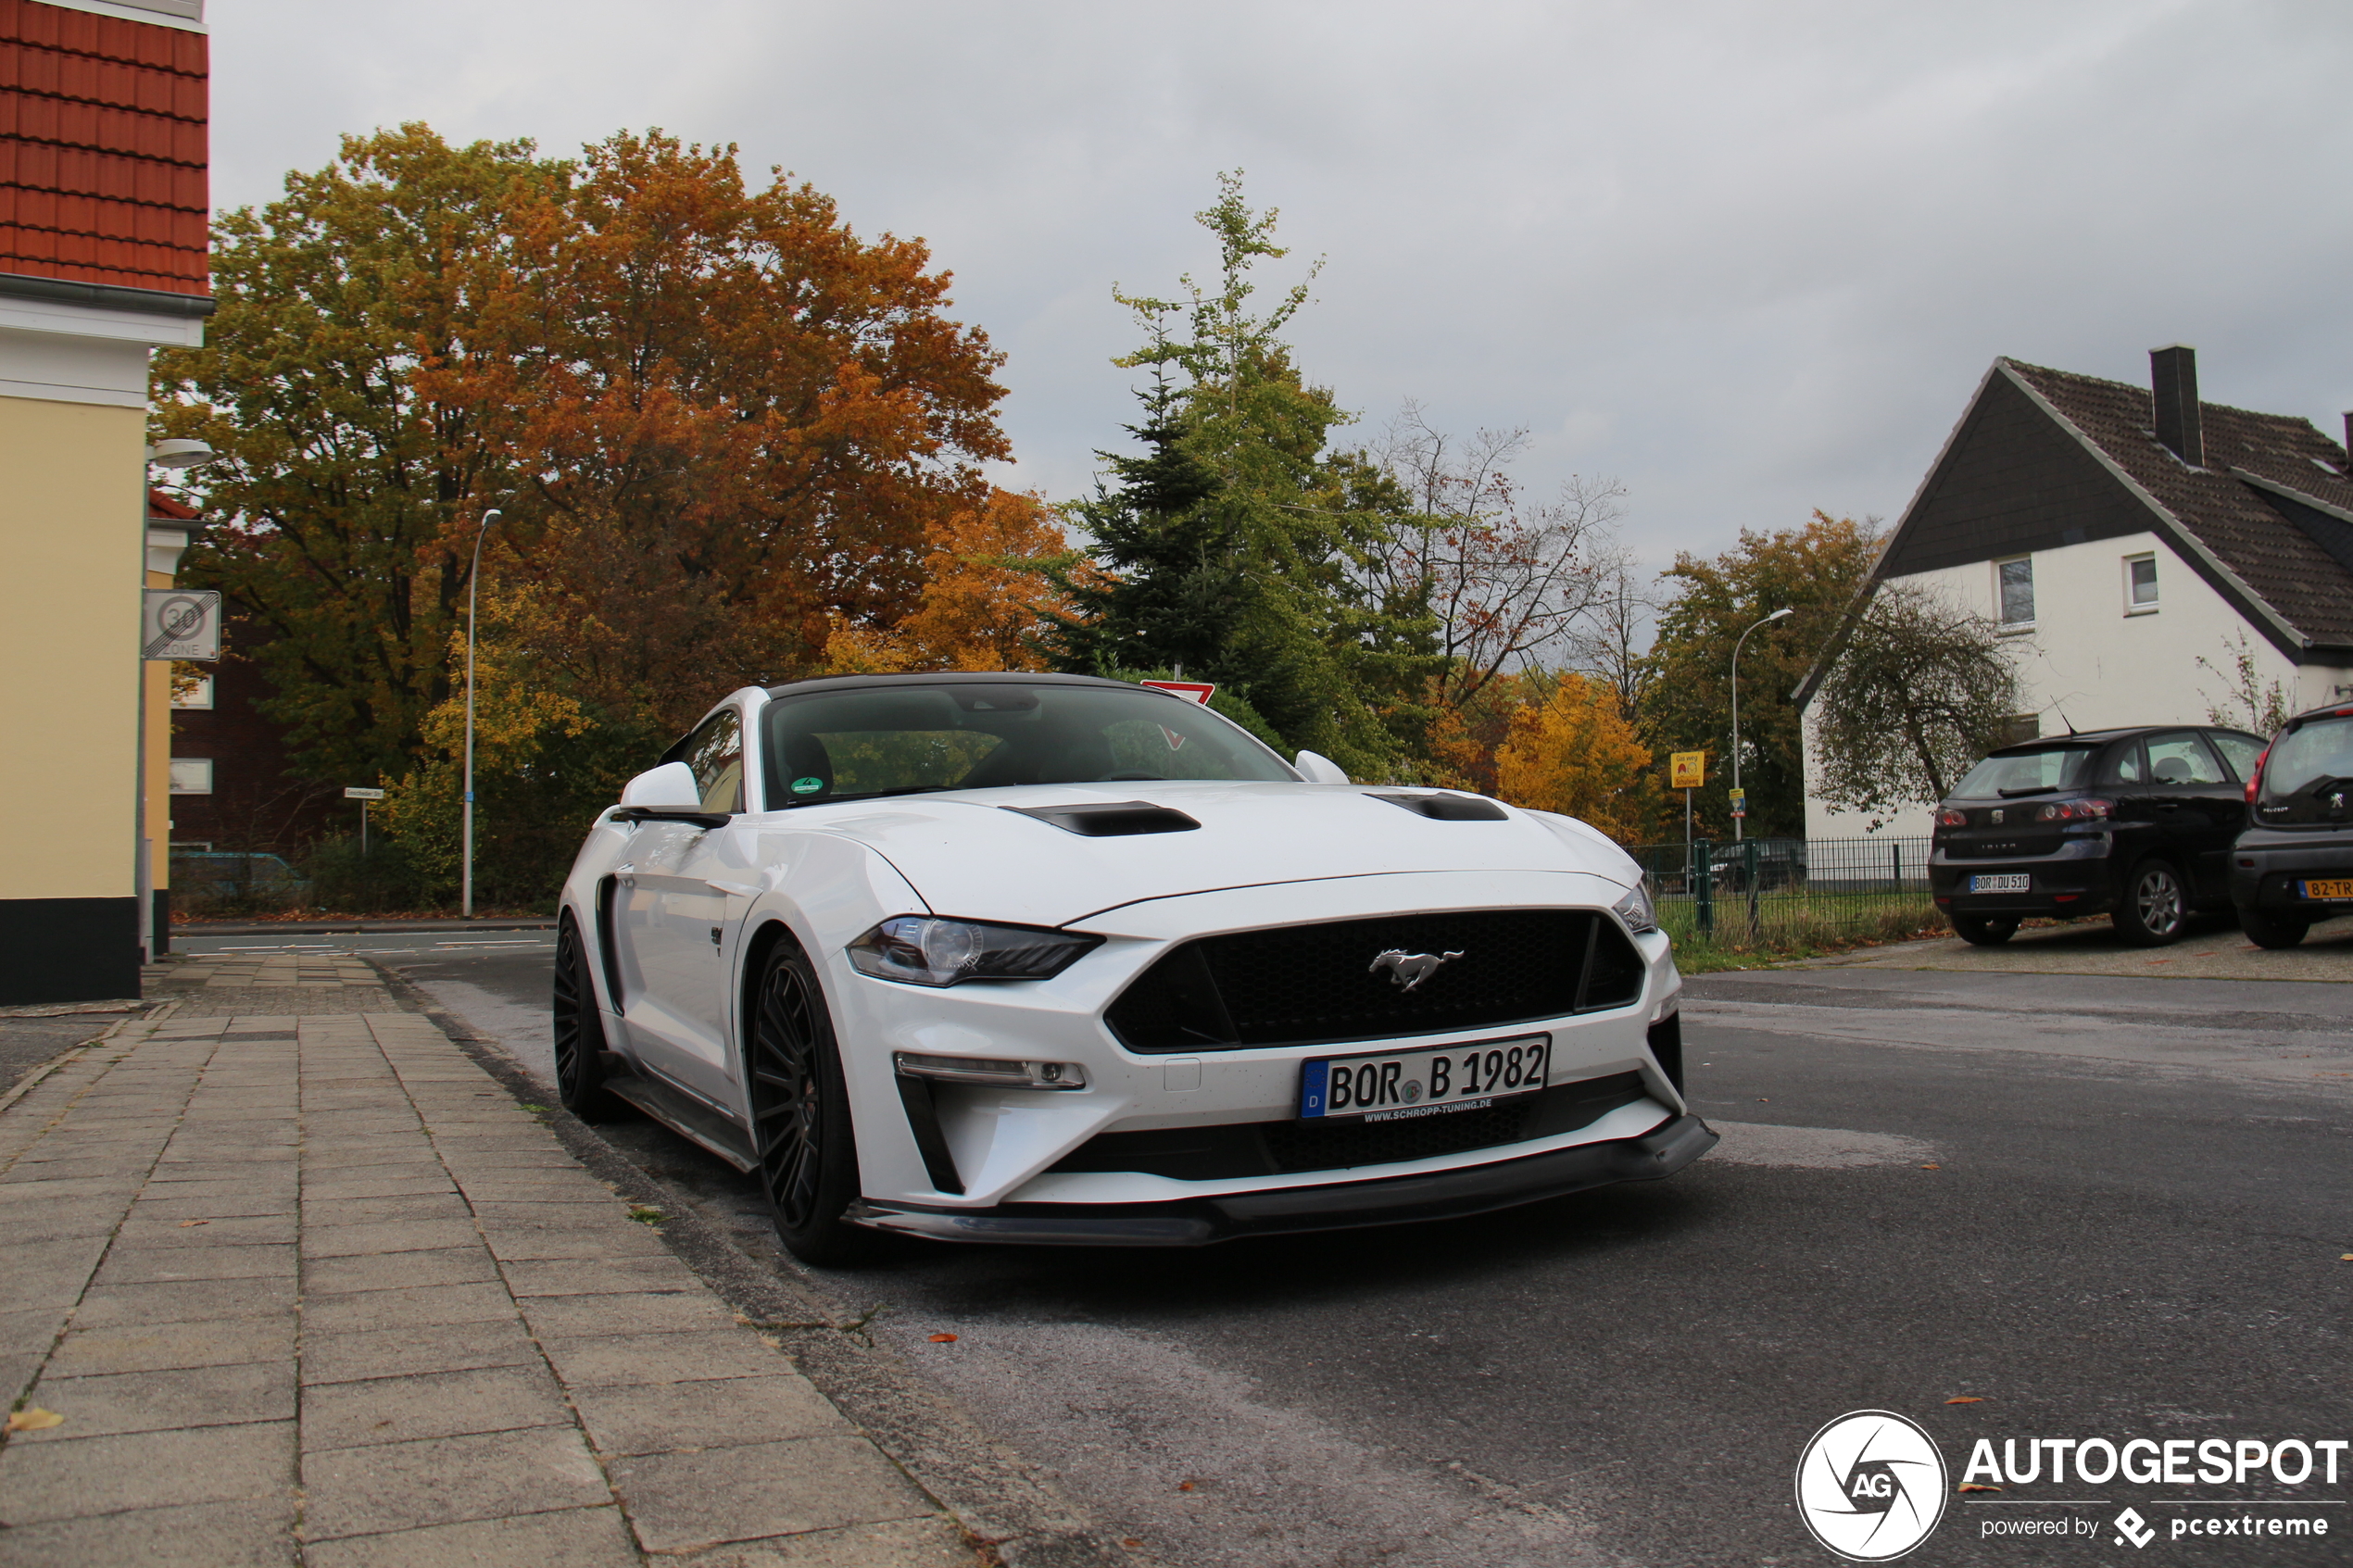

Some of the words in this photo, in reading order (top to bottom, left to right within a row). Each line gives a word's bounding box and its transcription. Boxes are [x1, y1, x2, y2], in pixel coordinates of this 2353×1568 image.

[163, 644, 200, 656] ZONE
[802, 777, 812, 785] 4
[1975, 876, 1992, 889] BOR
[1997, 876, 2009, 889] DU
[2011, 875, 2029, 888] 510
[1328, 1060, 1402, 1110] BOR
[1429, 1055, 1453, 1099] B
[1461, 1043, 1545, 1096] 1982
[1309, 1095, 1319, 1109] D
[1365, 1098, 1492, 1123] WWW.SCHROPP-TUNING.DE
